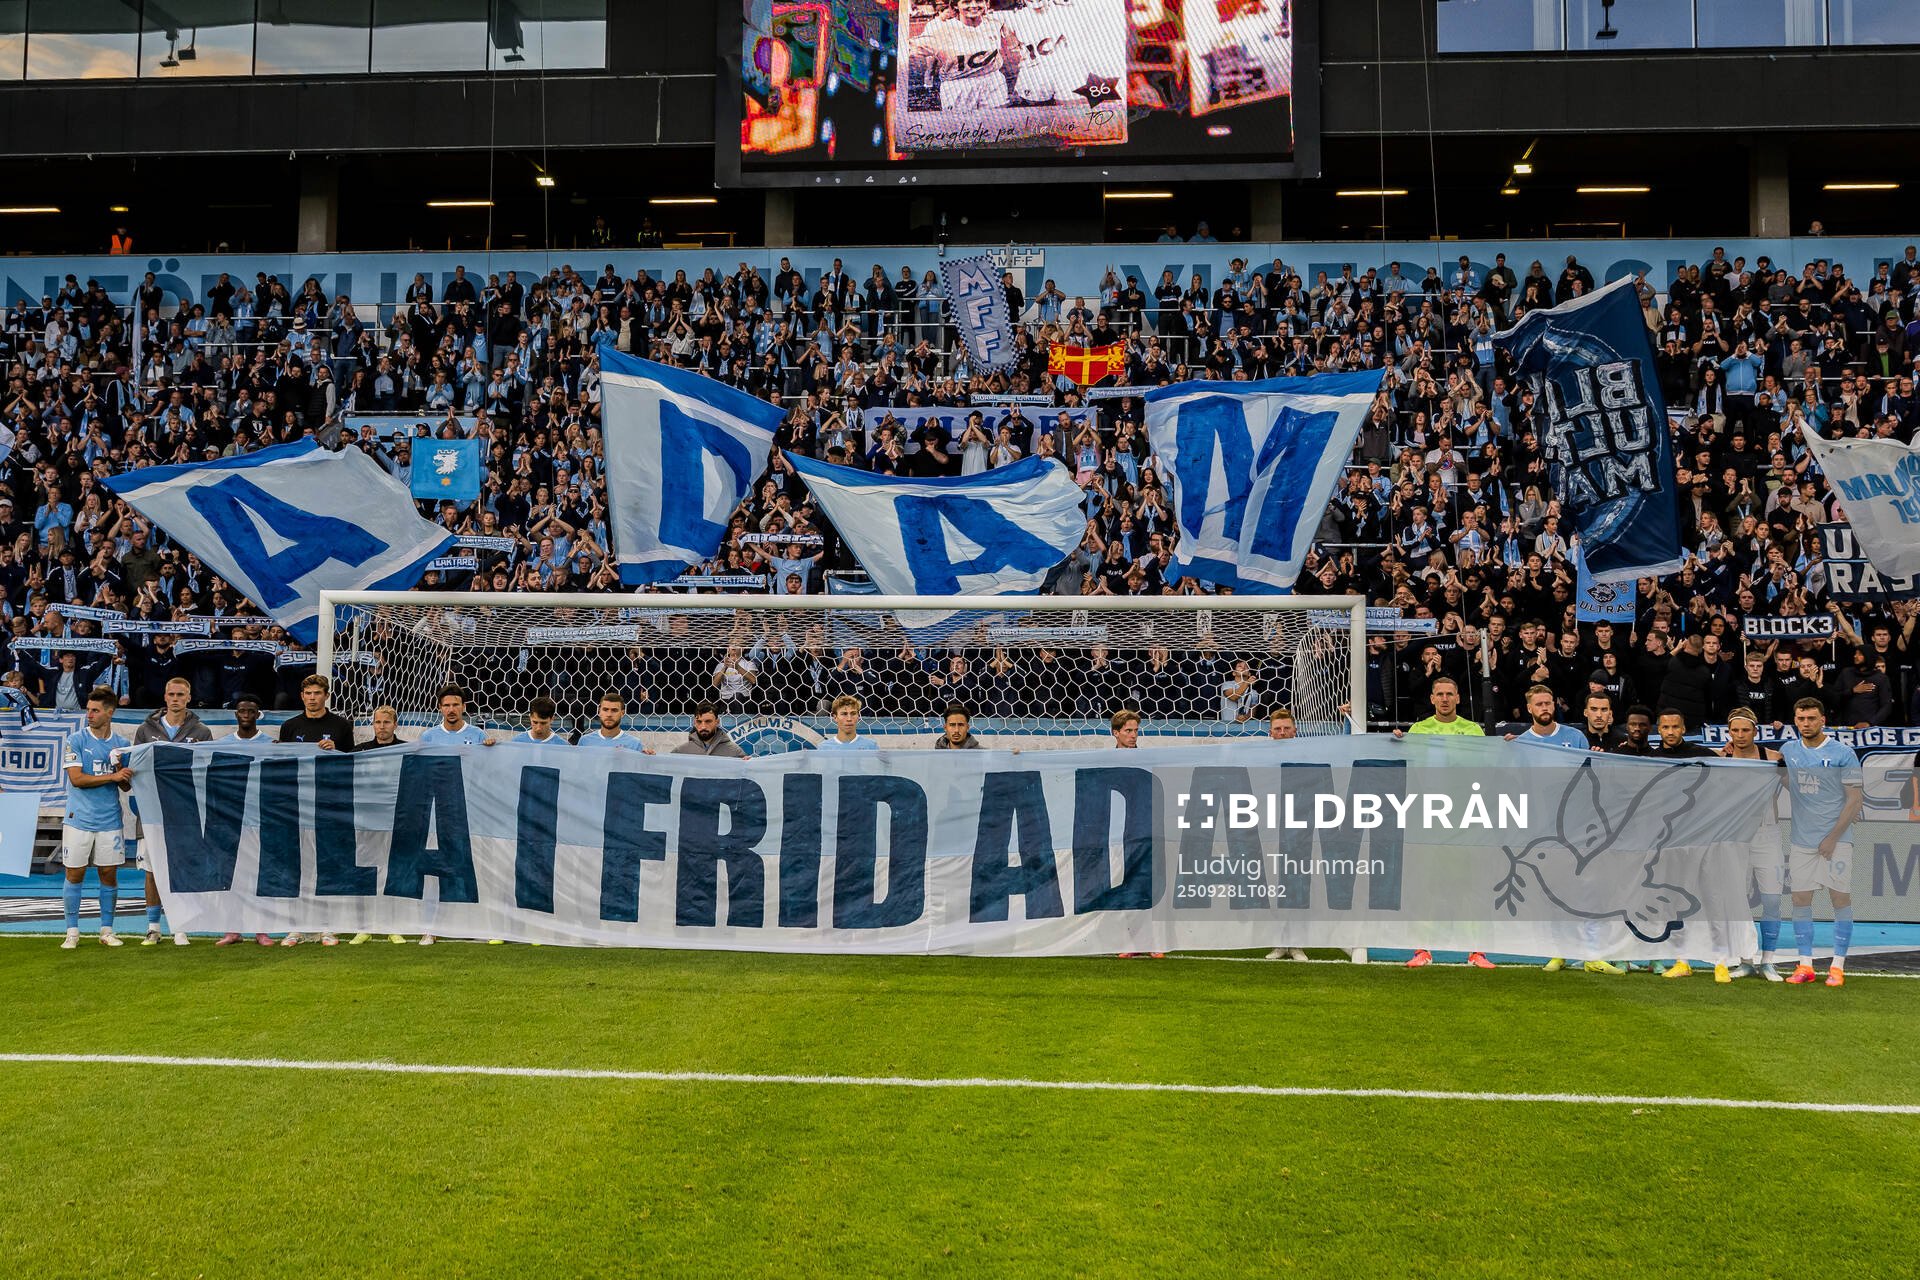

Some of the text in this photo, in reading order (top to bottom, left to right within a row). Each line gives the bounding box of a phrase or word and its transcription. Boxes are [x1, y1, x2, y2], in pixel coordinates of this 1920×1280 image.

[1089, 82, 1111, 98] 86
[959, 265, 1001, 364] MFF
[658, 399, 753, 557] D
[1175, 394, 1340, 563] M
[185, 473, 391, 610] A
[893, 493, 1068, 597] A
[1579, 600, 1636, 613] ULTRAS
[1743, 616, 1834, 636] BLOCK3
[729, 716, 794, 741] MALMÖ
[153, 745, 1408, 929] VILA I FRID ADAM
